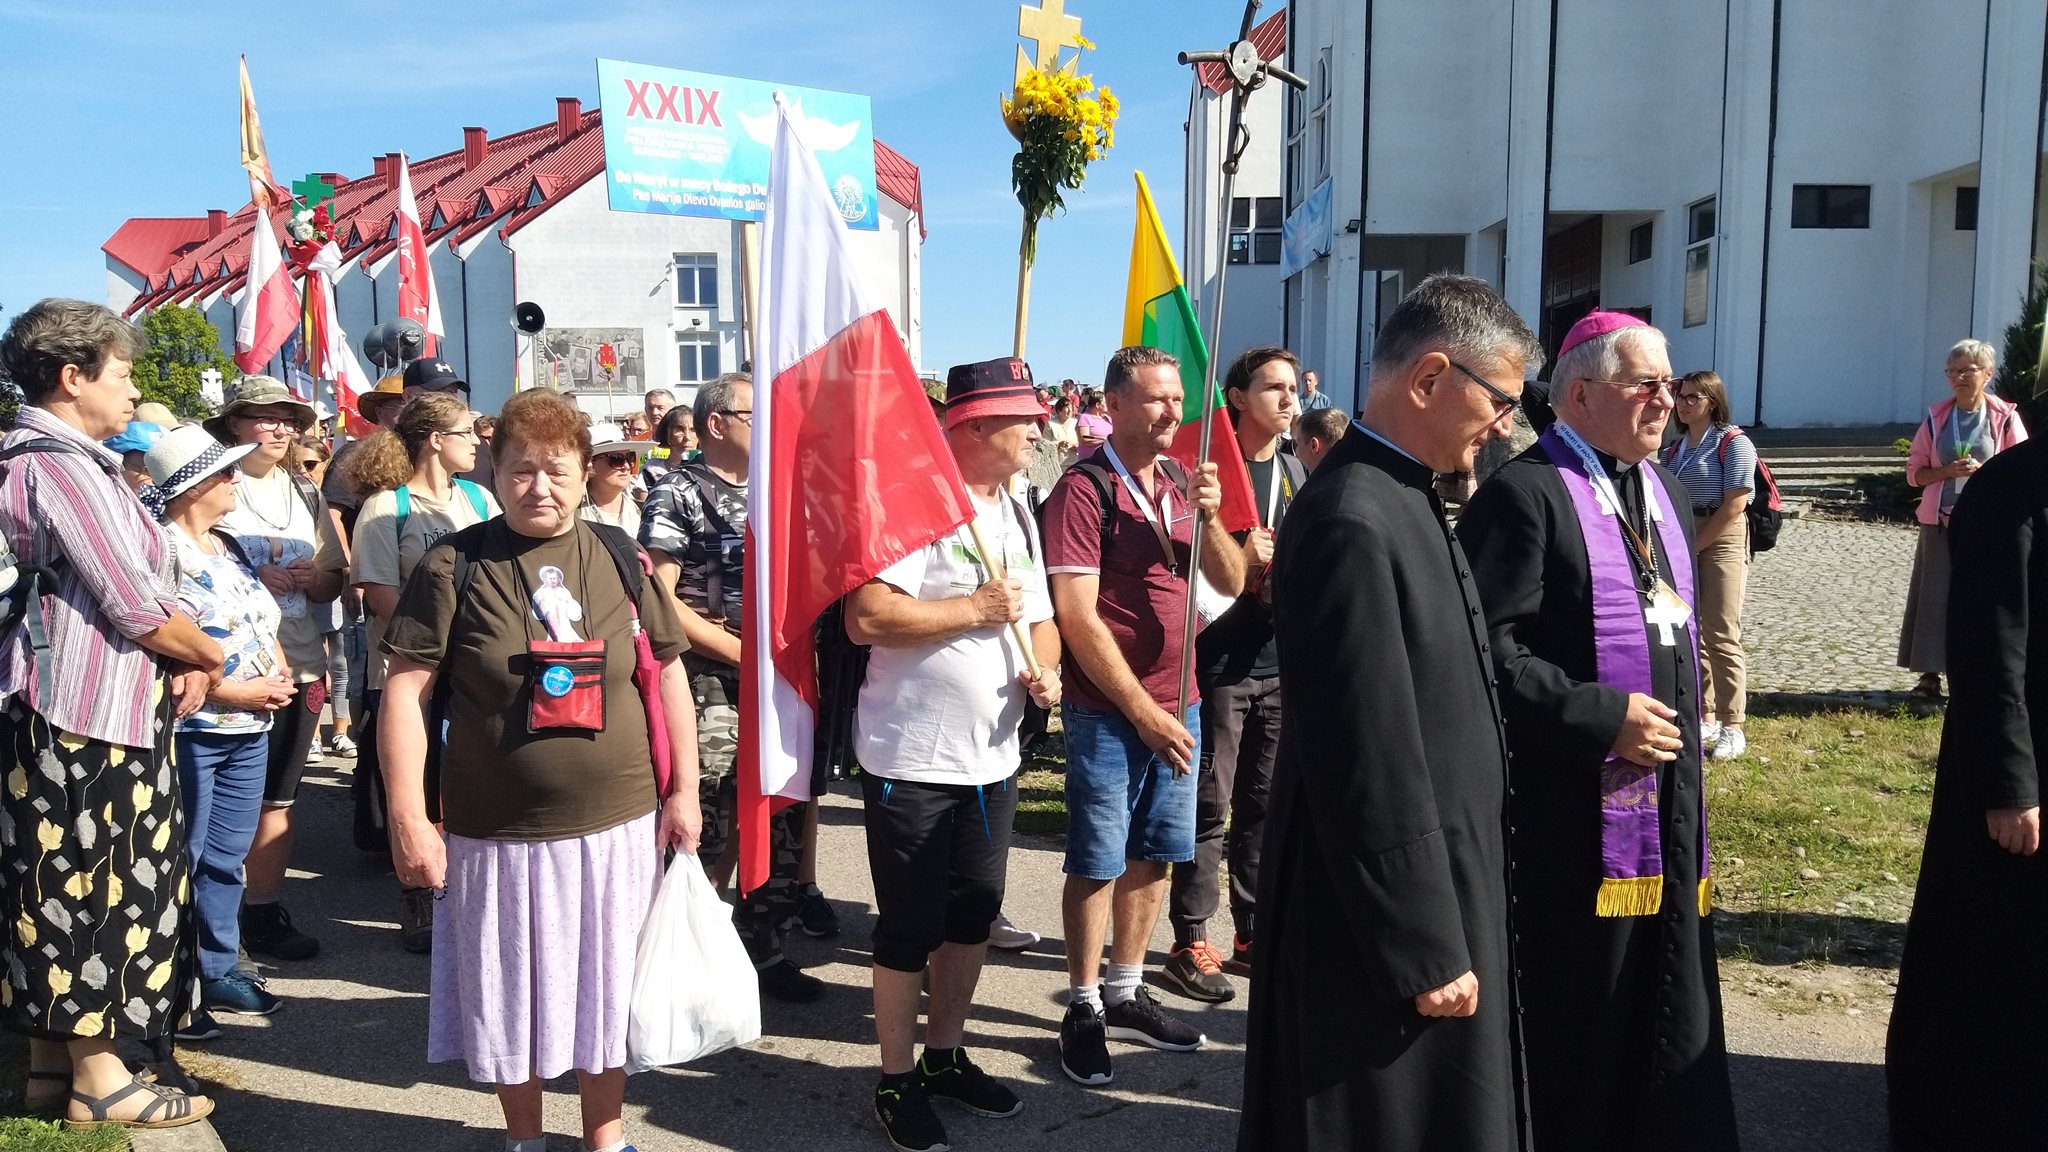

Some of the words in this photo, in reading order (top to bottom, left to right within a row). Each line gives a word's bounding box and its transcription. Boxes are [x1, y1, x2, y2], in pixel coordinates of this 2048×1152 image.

[624, 78, 722, 127] XXIX
[615, 170, 632, 183] Do
[632, 189, 650, 201] Pas
[683, 193, 708, 206] Dievo
[745, 199, 766, 211] galio
[1565, 430, 1578, 445] MARYI
[1582, 448, 1596, 464] MOCY
